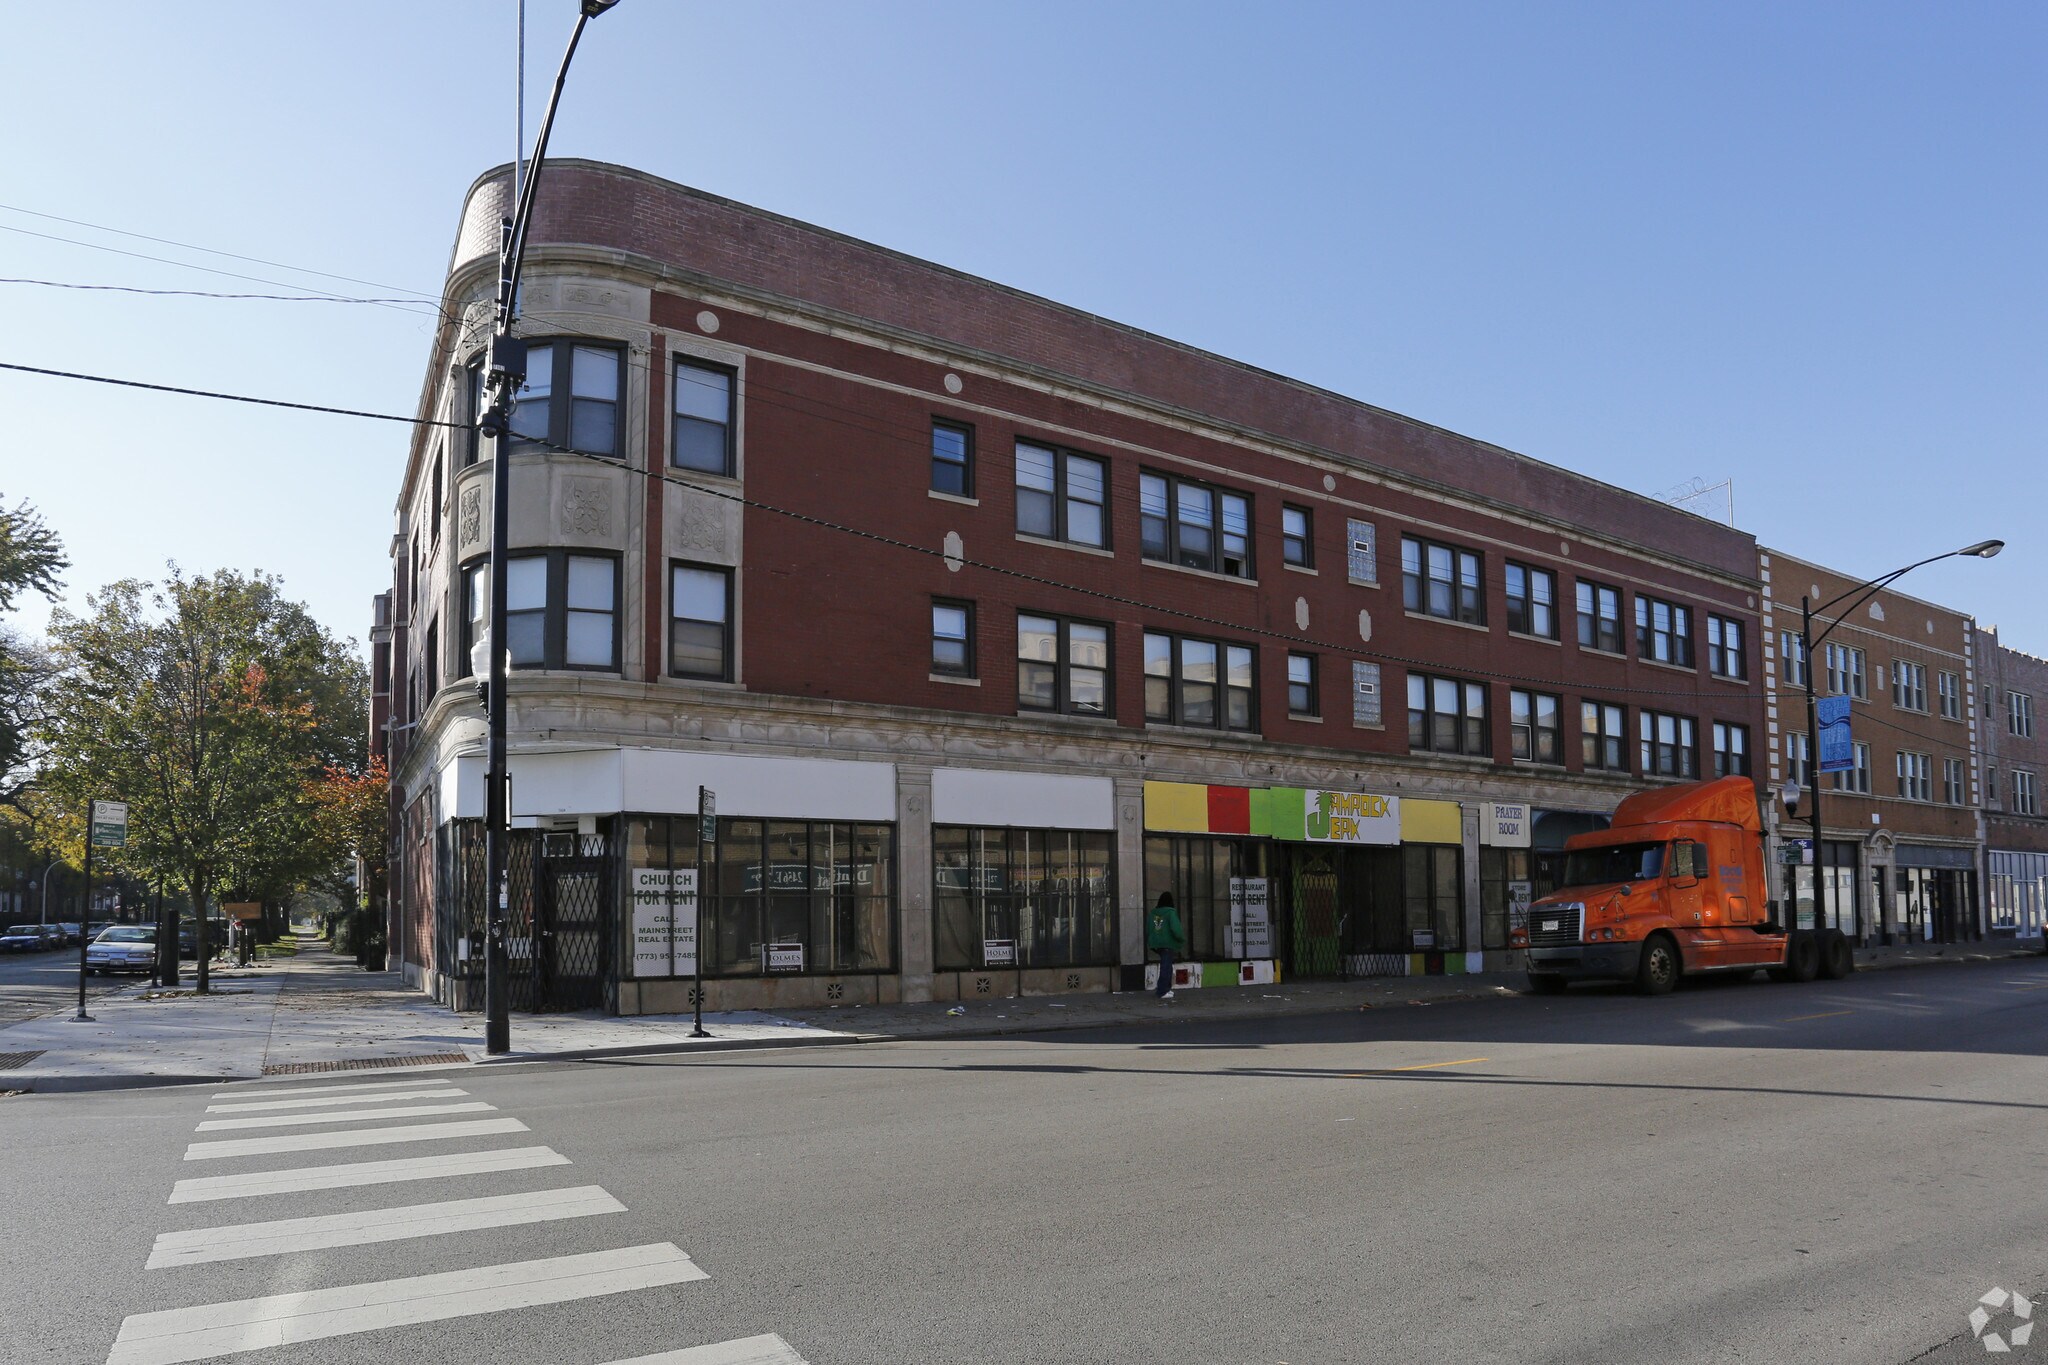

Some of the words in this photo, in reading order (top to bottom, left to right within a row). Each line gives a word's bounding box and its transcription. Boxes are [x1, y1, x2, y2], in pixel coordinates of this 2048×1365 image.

[1496, 806, 1522, 819] PRAYER
[1499, 823, 1519, 835] ROOM
[637, 890, 660, 906] FOR
[1247, 894, 1266, 906] RENT
[636, 953, 658, 961] (773)
[660, 952, 696, 960] 95-7485
[769, 954, 801, 962] OLMES
[986, 949, 1012, 957] HOLME
